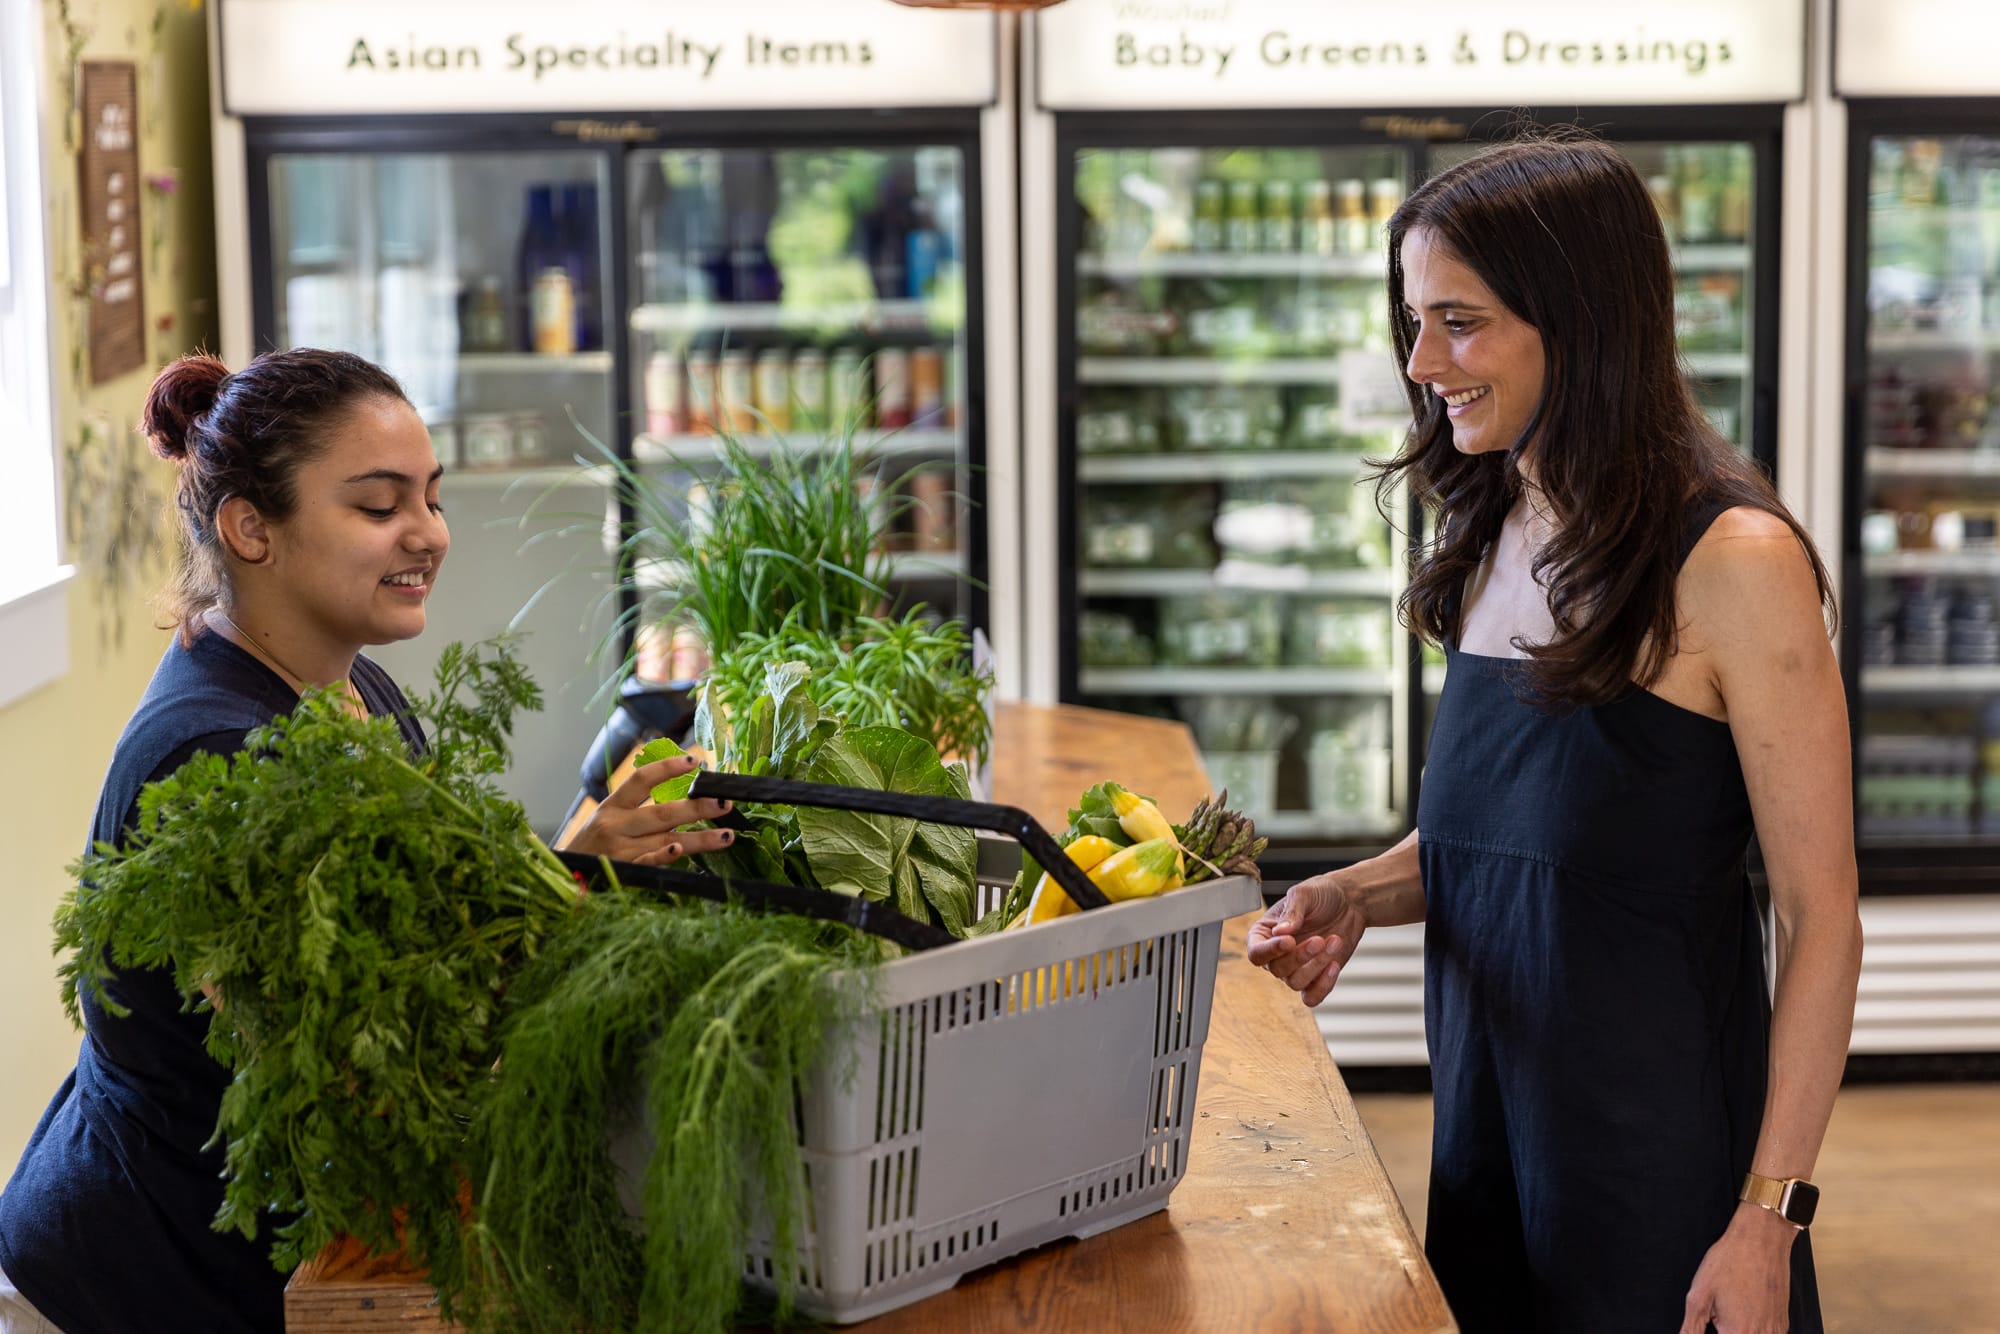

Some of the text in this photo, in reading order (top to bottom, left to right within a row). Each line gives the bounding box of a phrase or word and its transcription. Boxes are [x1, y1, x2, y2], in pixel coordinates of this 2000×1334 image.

[345, 32, 874, 80] Asian Specialty Items
[1113, 31, 1734, 77] Baby Greens & Dressings
